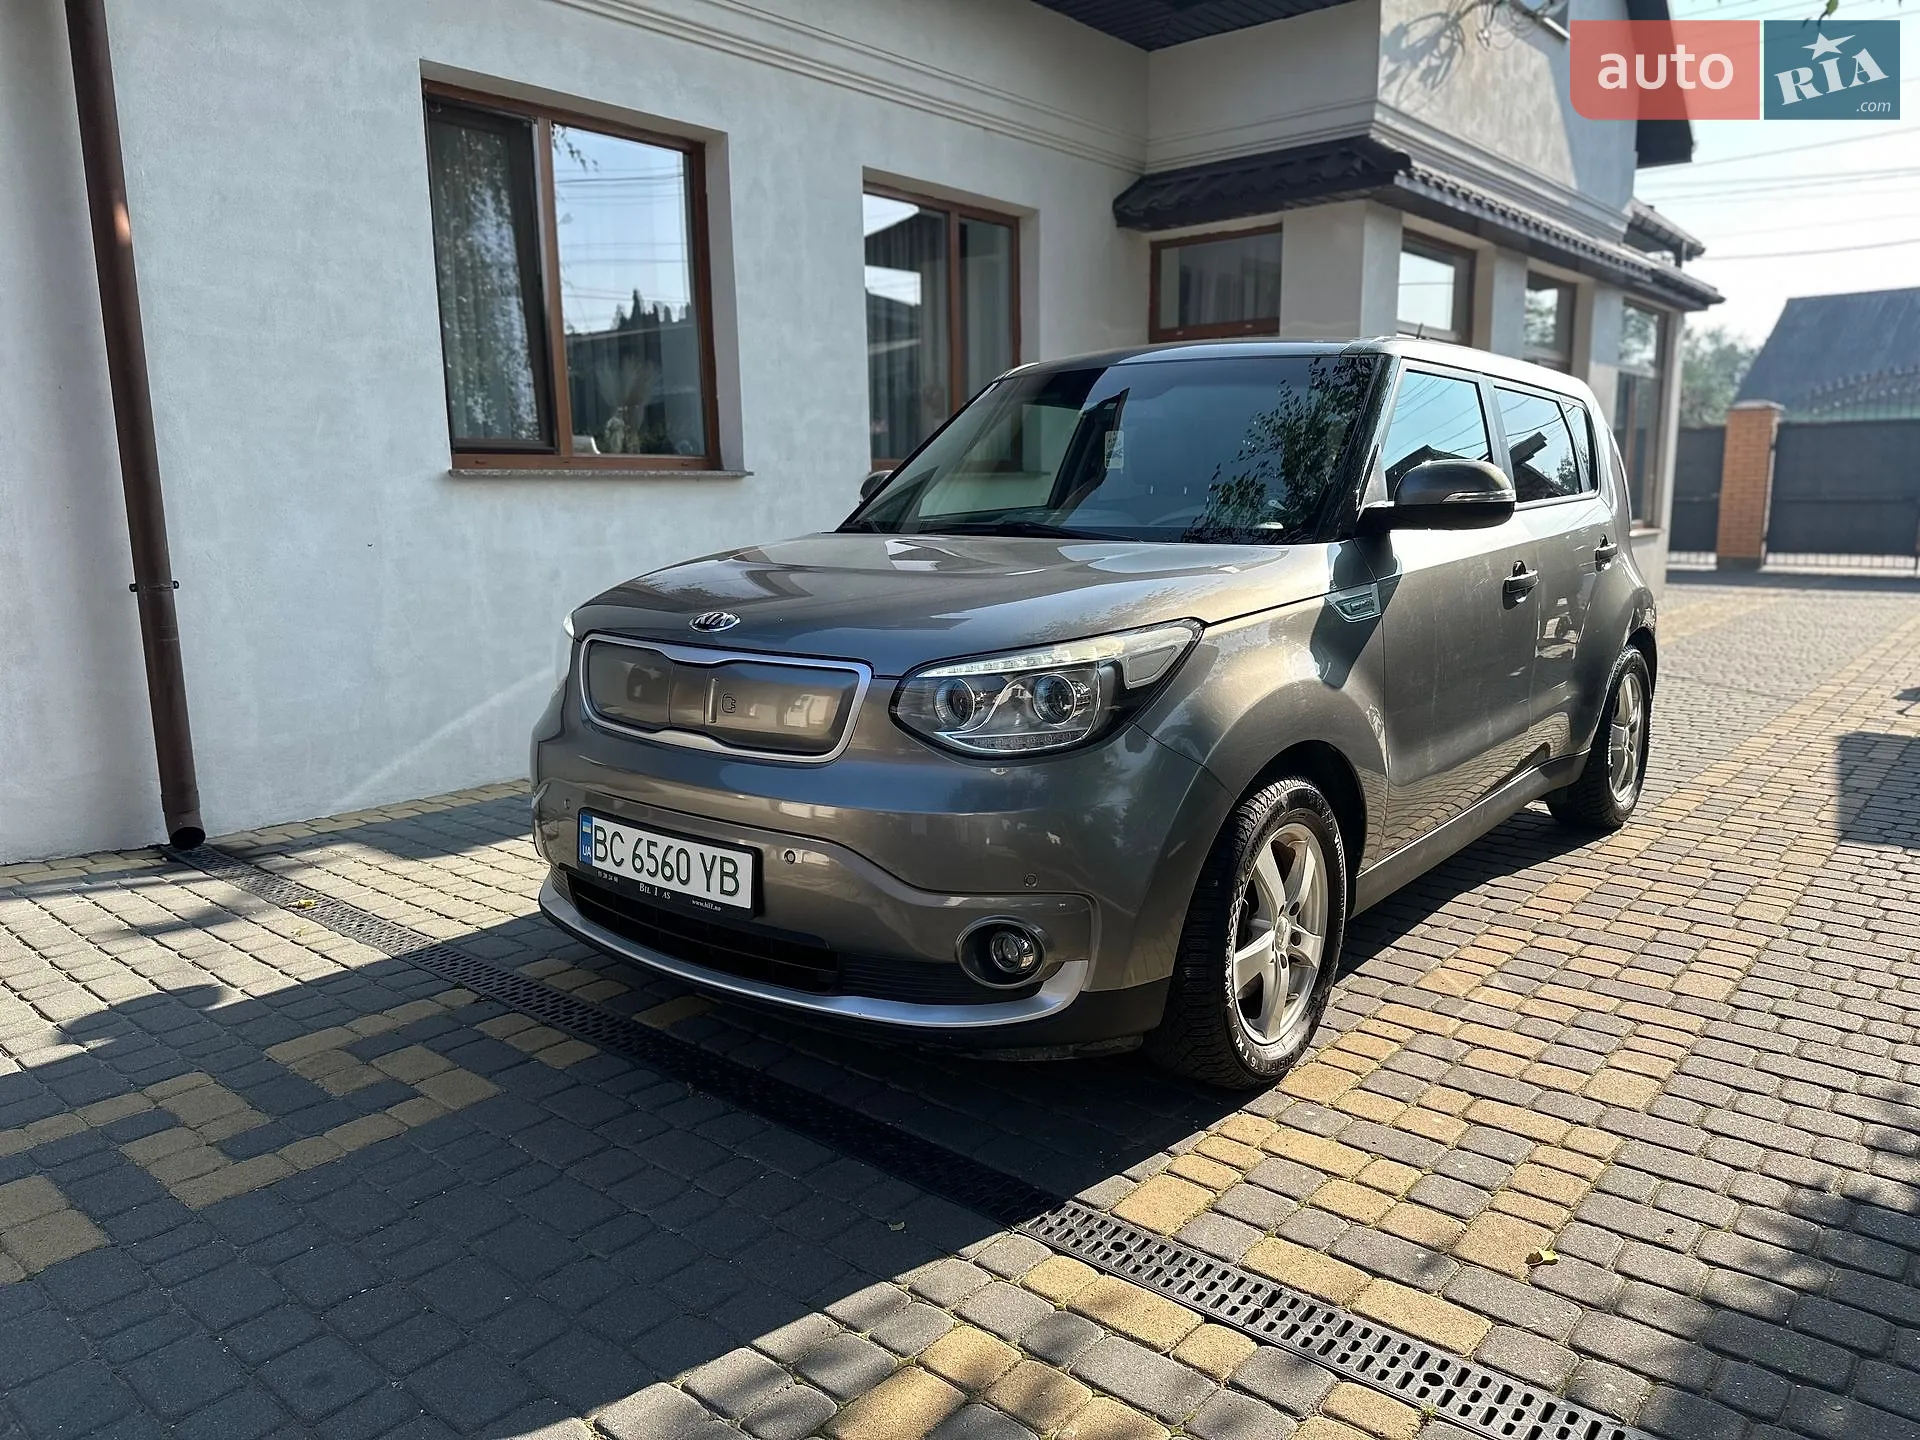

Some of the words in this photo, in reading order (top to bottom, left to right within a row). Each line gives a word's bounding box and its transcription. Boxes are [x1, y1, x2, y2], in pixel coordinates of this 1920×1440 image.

[582, 845, 592, 858] UA
[594, 824, 625, 867] BC
[631, 837, 691, 886] 6560
[699, 851, 740, 897] YB
